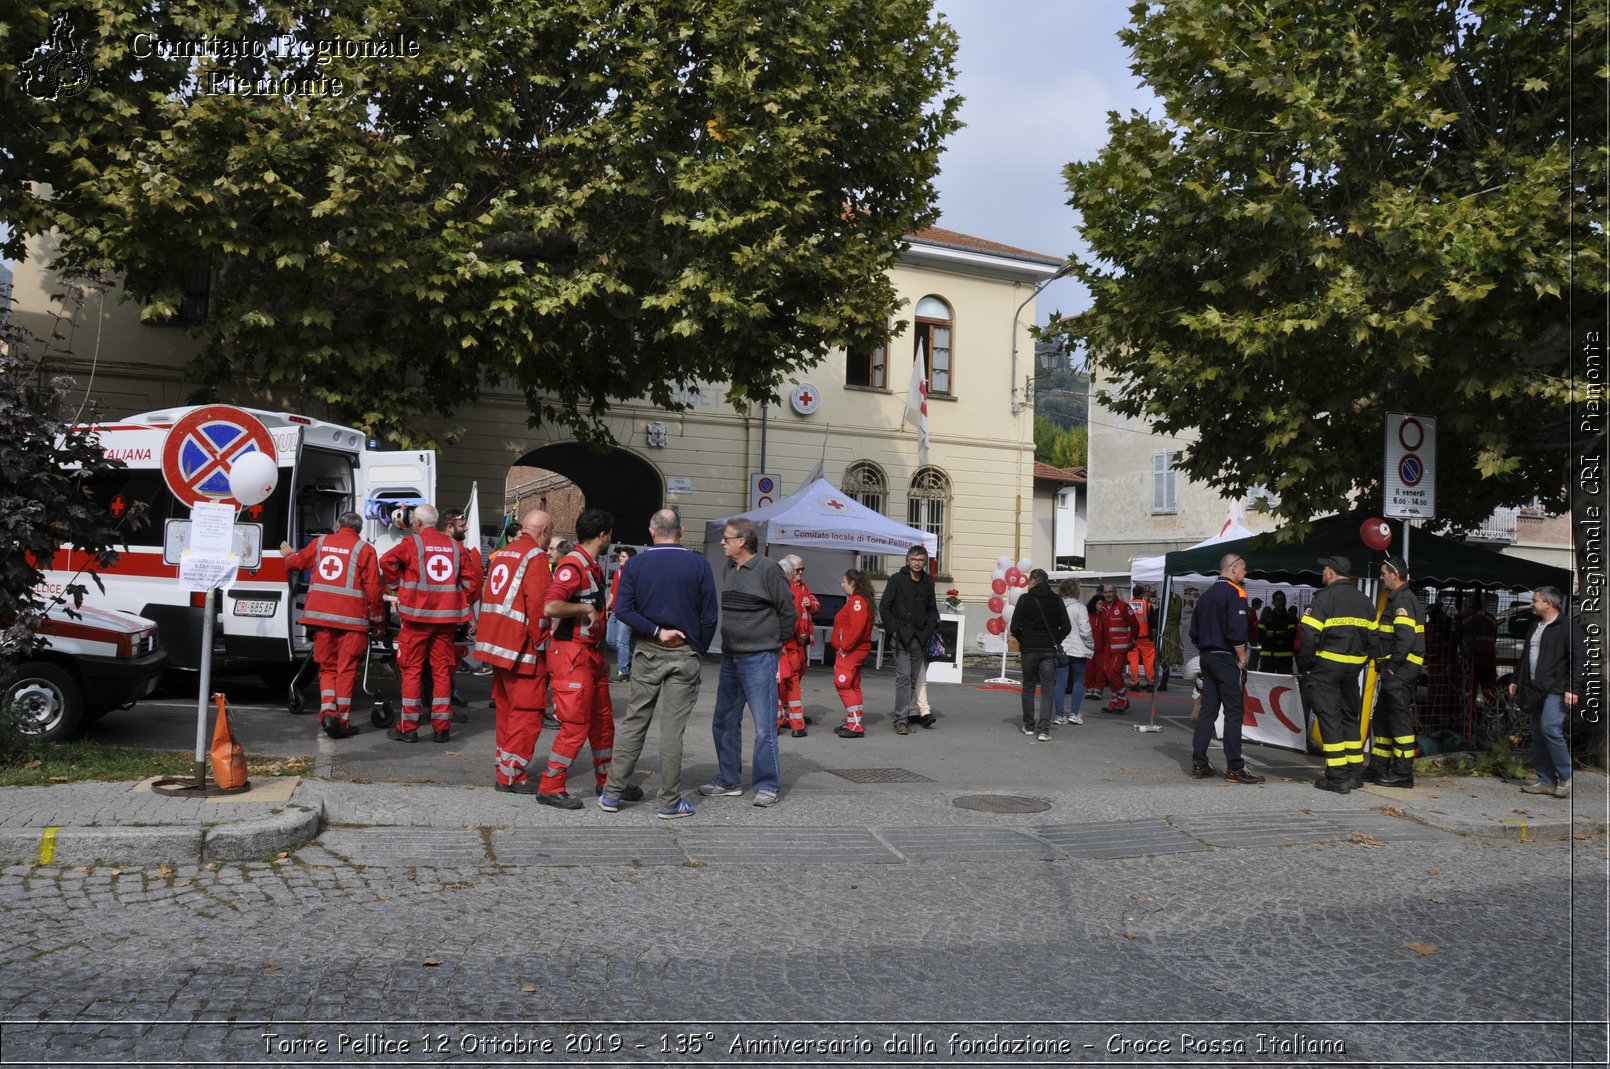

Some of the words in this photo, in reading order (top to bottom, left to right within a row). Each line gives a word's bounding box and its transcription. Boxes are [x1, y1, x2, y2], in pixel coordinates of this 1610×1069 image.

[794, 530, 829, 539] Comitato
[831, 532, 854, 542] locale
[866, 536, 887, 545] Torre
[888, 538, 913, 547] Pellice
